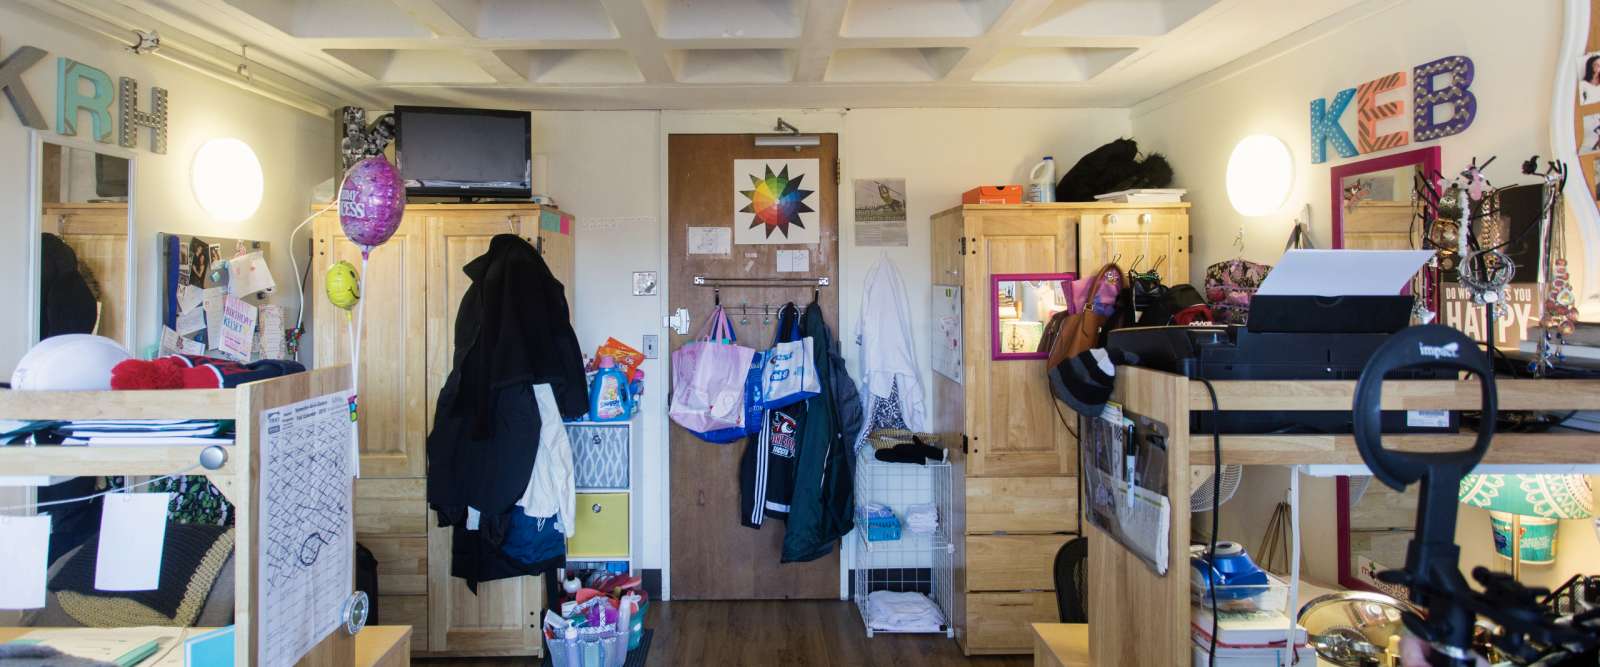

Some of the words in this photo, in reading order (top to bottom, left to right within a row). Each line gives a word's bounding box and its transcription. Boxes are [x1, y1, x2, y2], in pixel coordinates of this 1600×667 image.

[1310, 55, 1477, 164] KEB
[1445, 287, 1456, 300] DO
[1513, 287, 1531, 301] YOU
